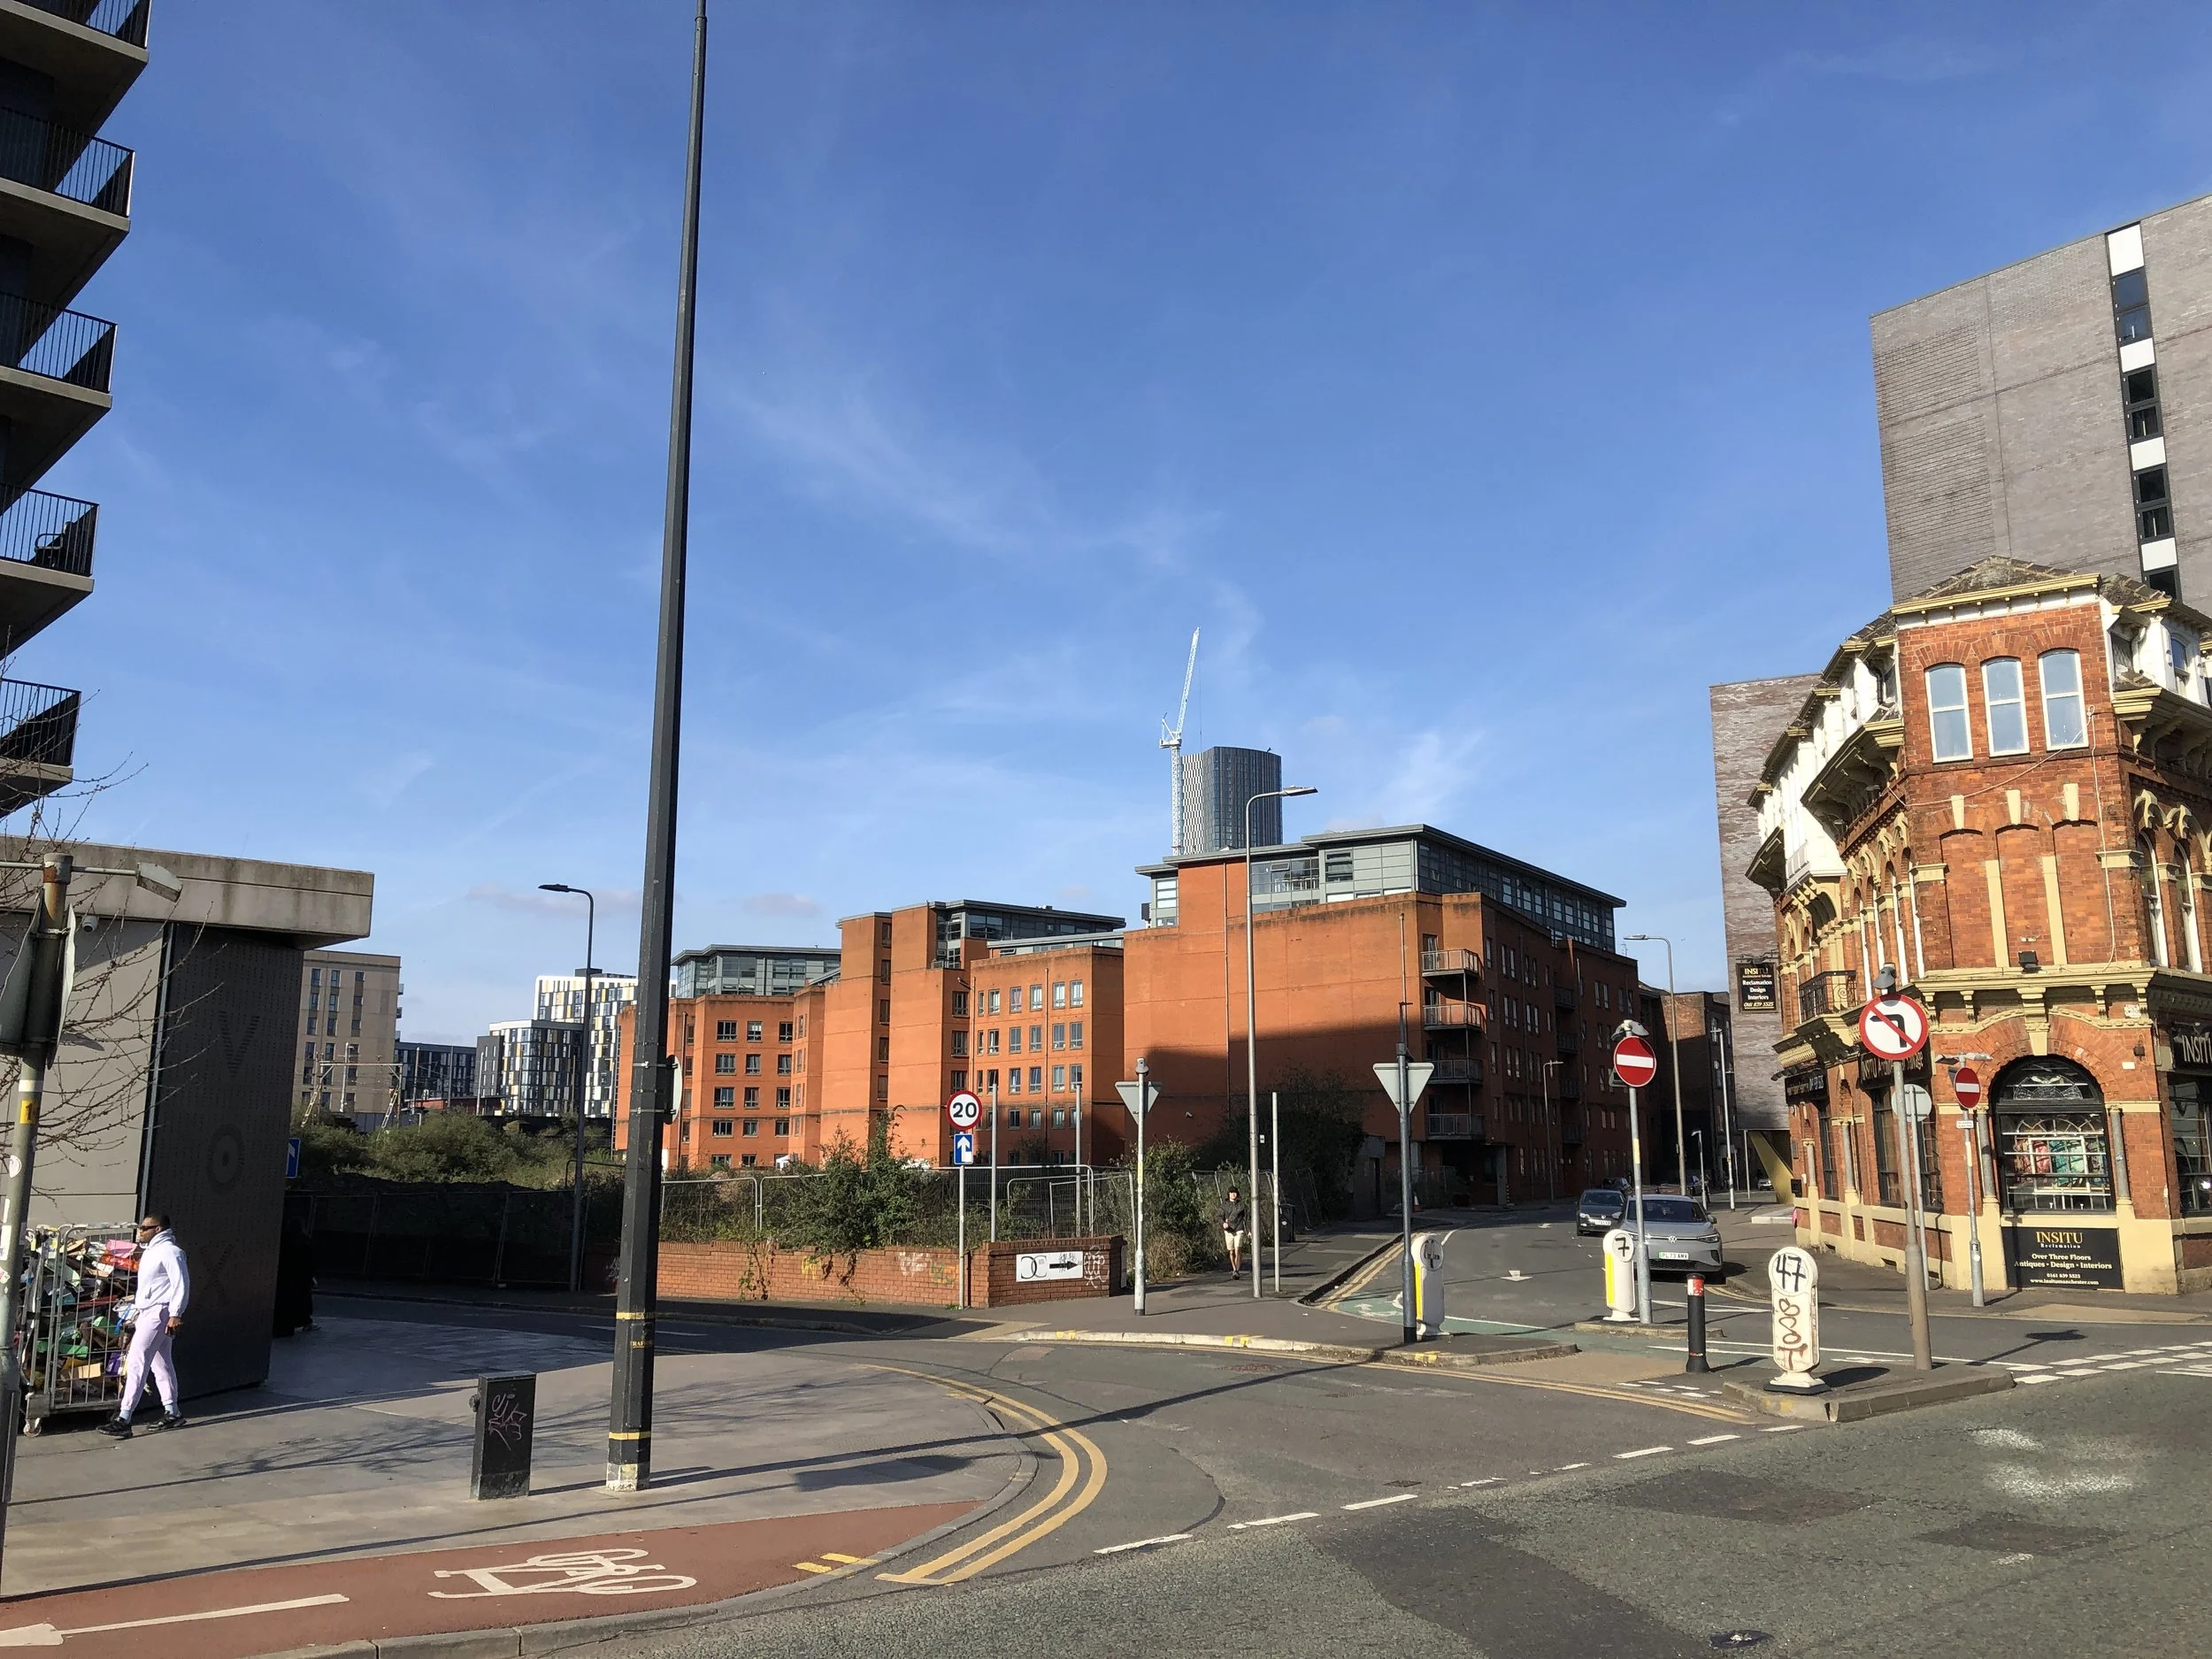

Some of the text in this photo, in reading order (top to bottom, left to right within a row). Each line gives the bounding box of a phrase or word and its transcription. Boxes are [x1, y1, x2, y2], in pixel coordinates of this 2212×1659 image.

[952, 1102, 977, 1118] 20
[2035, 1231, 2084, 1244] INSITU
[2014, 1260, 2046, 1269] Antiques
[2050, 1261, 2075, 1270] Design
[1775, 1253, 1808, 1293] 47
